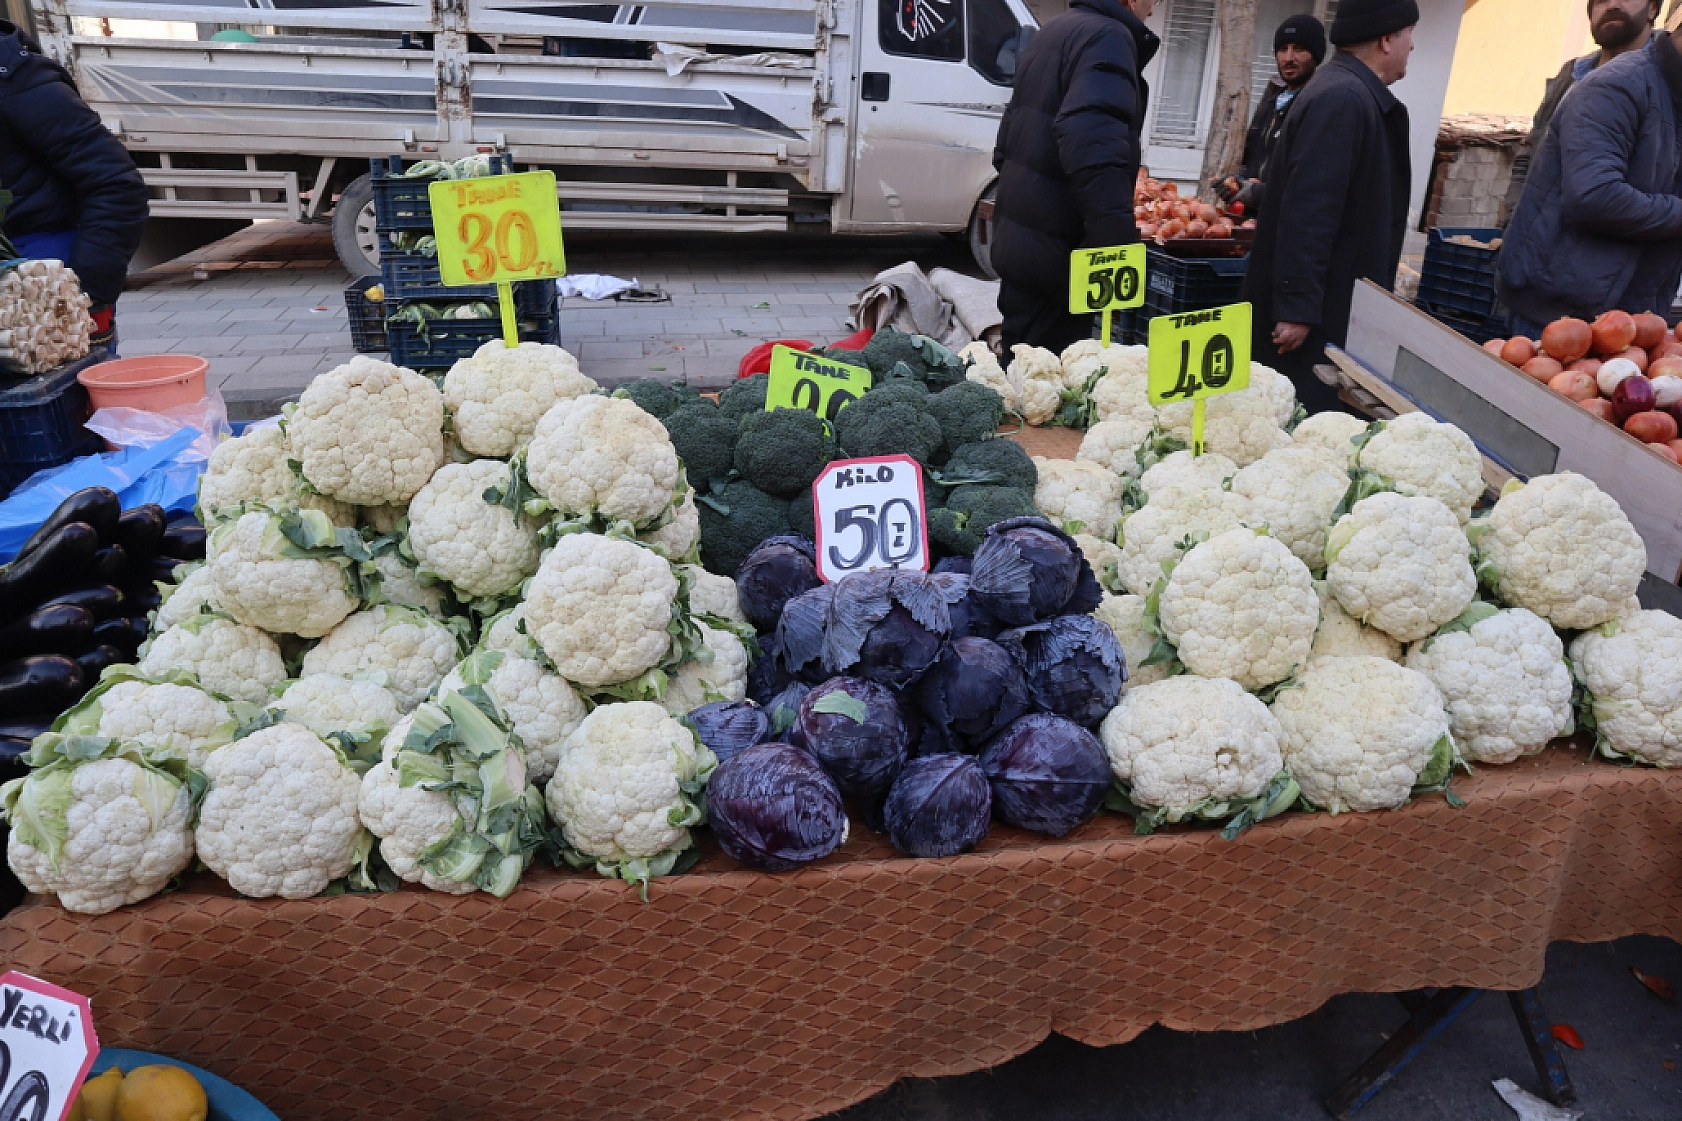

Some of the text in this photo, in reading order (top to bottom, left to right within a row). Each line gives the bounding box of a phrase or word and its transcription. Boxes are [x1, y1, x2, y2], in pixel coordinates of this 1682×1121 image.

[458, 209, 538, 281] 30
[1086, 249, 1127, 266] TANE
[1087, 265, 1139, 309] 50
[1168, 309, 1223, 329] TANE
[789, 351, 851, 380] TANE
[1160, 333, 1234, 399] 40
[828, 498, 920, 571] 50
